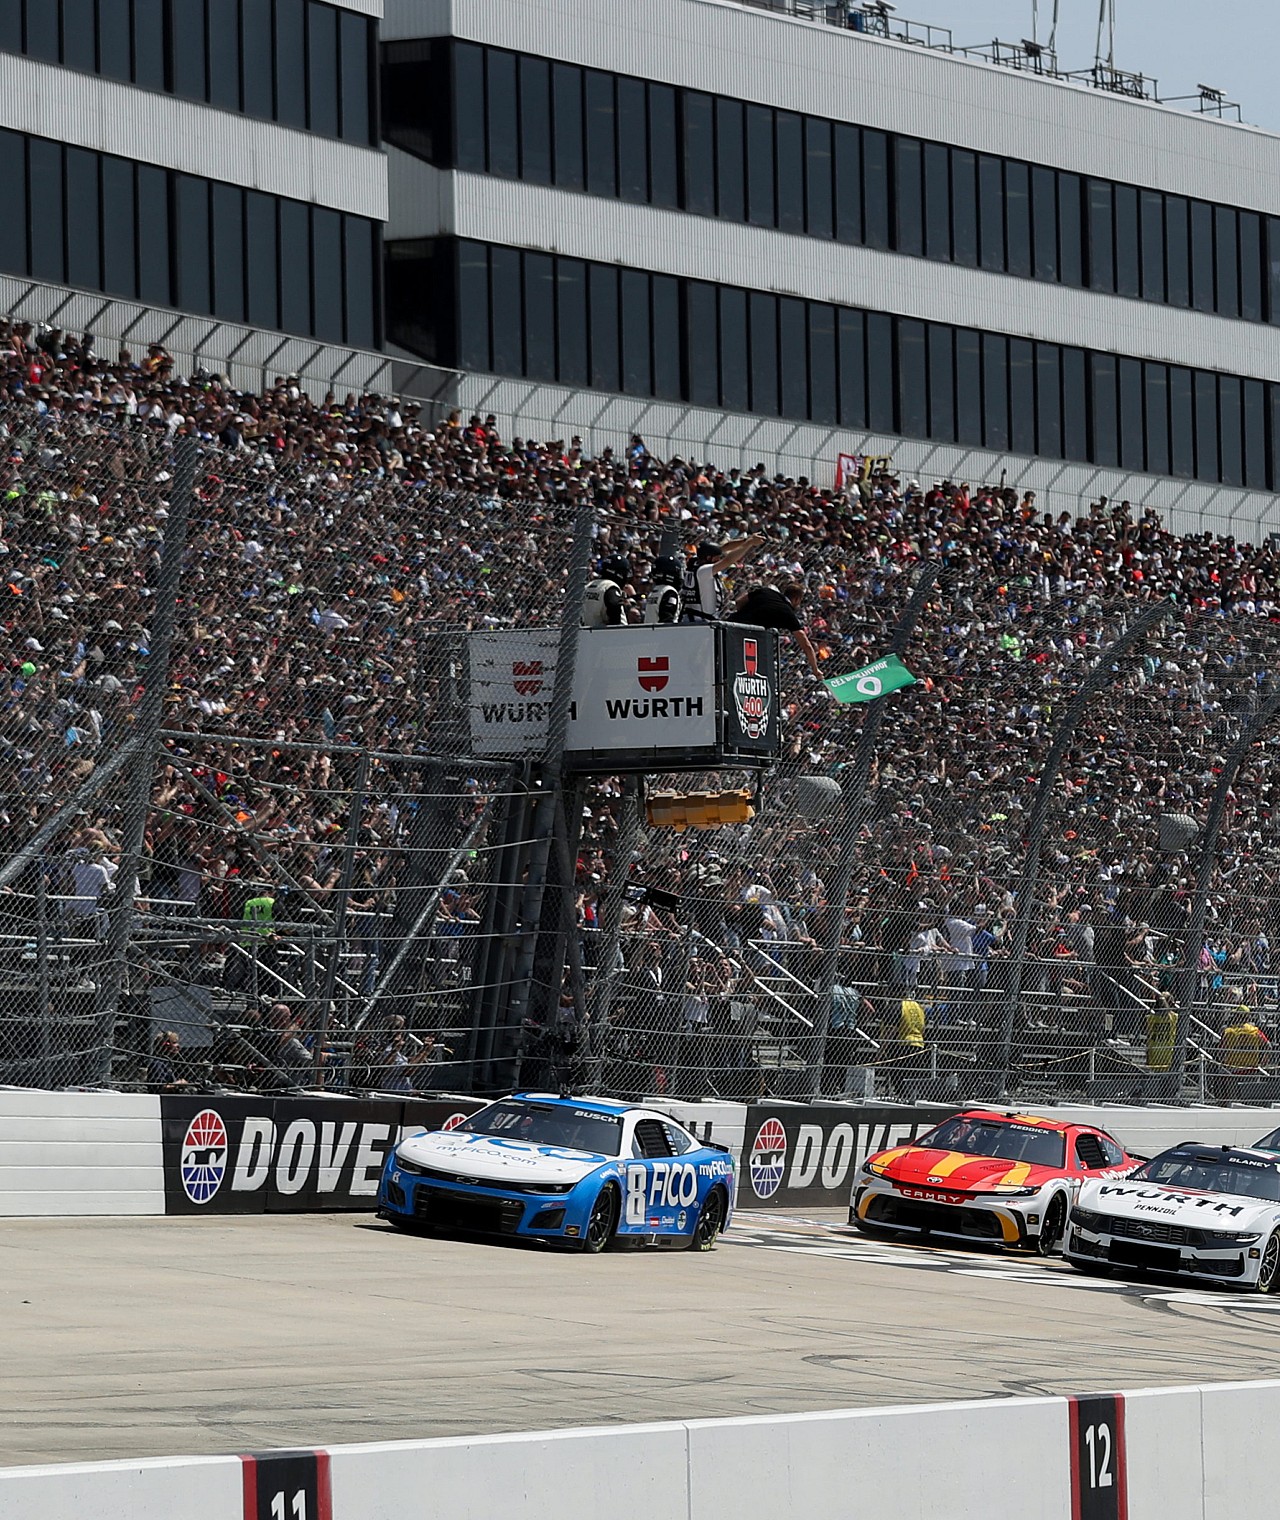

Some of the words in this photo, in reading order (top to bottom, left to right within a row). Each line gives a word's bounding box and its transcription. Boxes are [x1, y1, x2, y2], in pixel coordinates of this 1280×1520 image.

[738, 677, 767, 696] WÜRTH
[606, 696, 703, 719] WÜRTH
[743, 696, 762, 717] 400
[574, 1110, 618, 1124] BUSCH
[1010, 1124, 1050, 1135] REDDICK
[436, 1145, 537, 1166] myFICO.com
[1228, 1157, 1271, 1169] BLANEY
[626, 1163, 647, 1225] 8
[649, 1162, 698, 1208] FICO
[903, 1189, 961, 1203] CAMRY
[1100, 1186, 1245, 1218] WÜRTH
[1133, 1203, 1177, 1216] PENNZOIL
[1085, 1422, 1113, 1489] 12
[271, 1489, 306, 1520] 11
